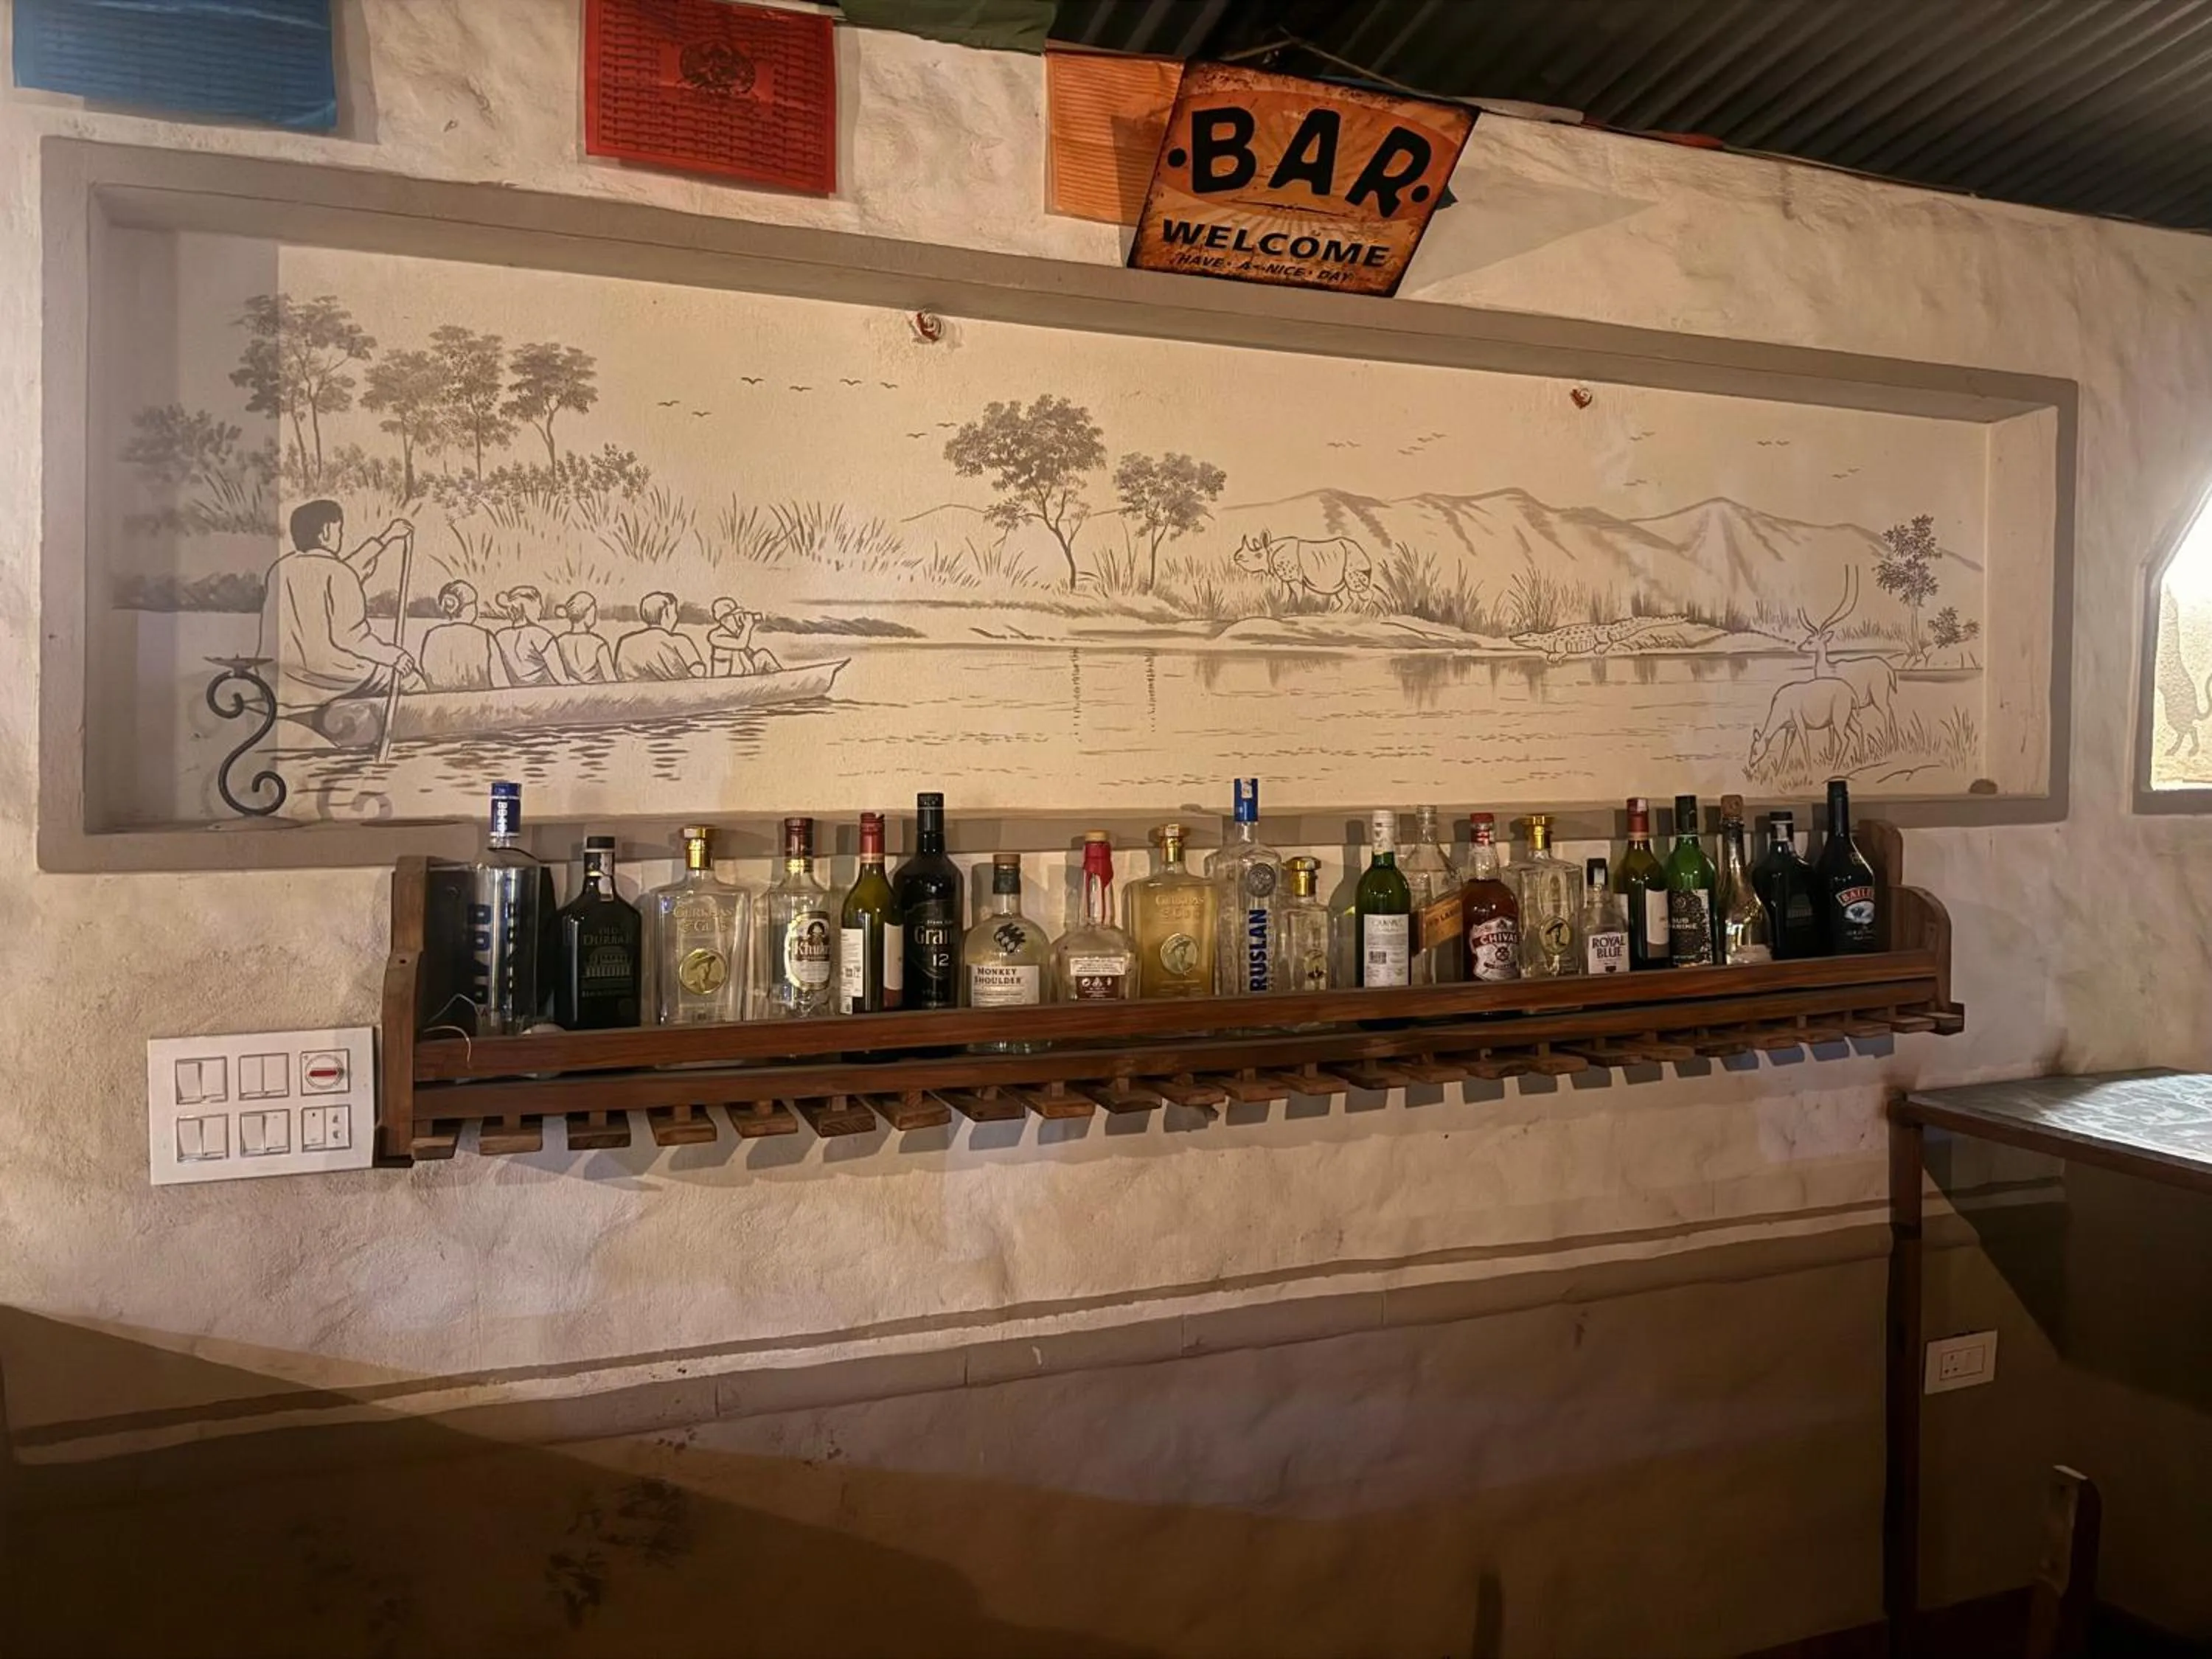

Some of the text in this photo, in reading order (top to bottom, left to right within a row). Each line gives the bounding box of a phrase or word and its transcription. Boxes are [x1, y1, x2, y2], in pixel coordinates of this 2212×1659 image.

[1192, 106, 1432, 218] BAR
[1163, 219, 1390, 268] WELCOME
[1176, 252, 1225, 268] HAVE
[1265, 262, 1306, 277] NICE
[1316, 269, 1356, 284] DAY
[1592, 935, 1625, 949] ROYAL
[1249, 909, 1267, 992] RUSLAN
[1596, 947, 1622, 959] BLUE
[933, 953, 949, 967] 12
[977, 967, 1017, 975] MONKEY
[974, 975, 1020, 984] SHOULDER
